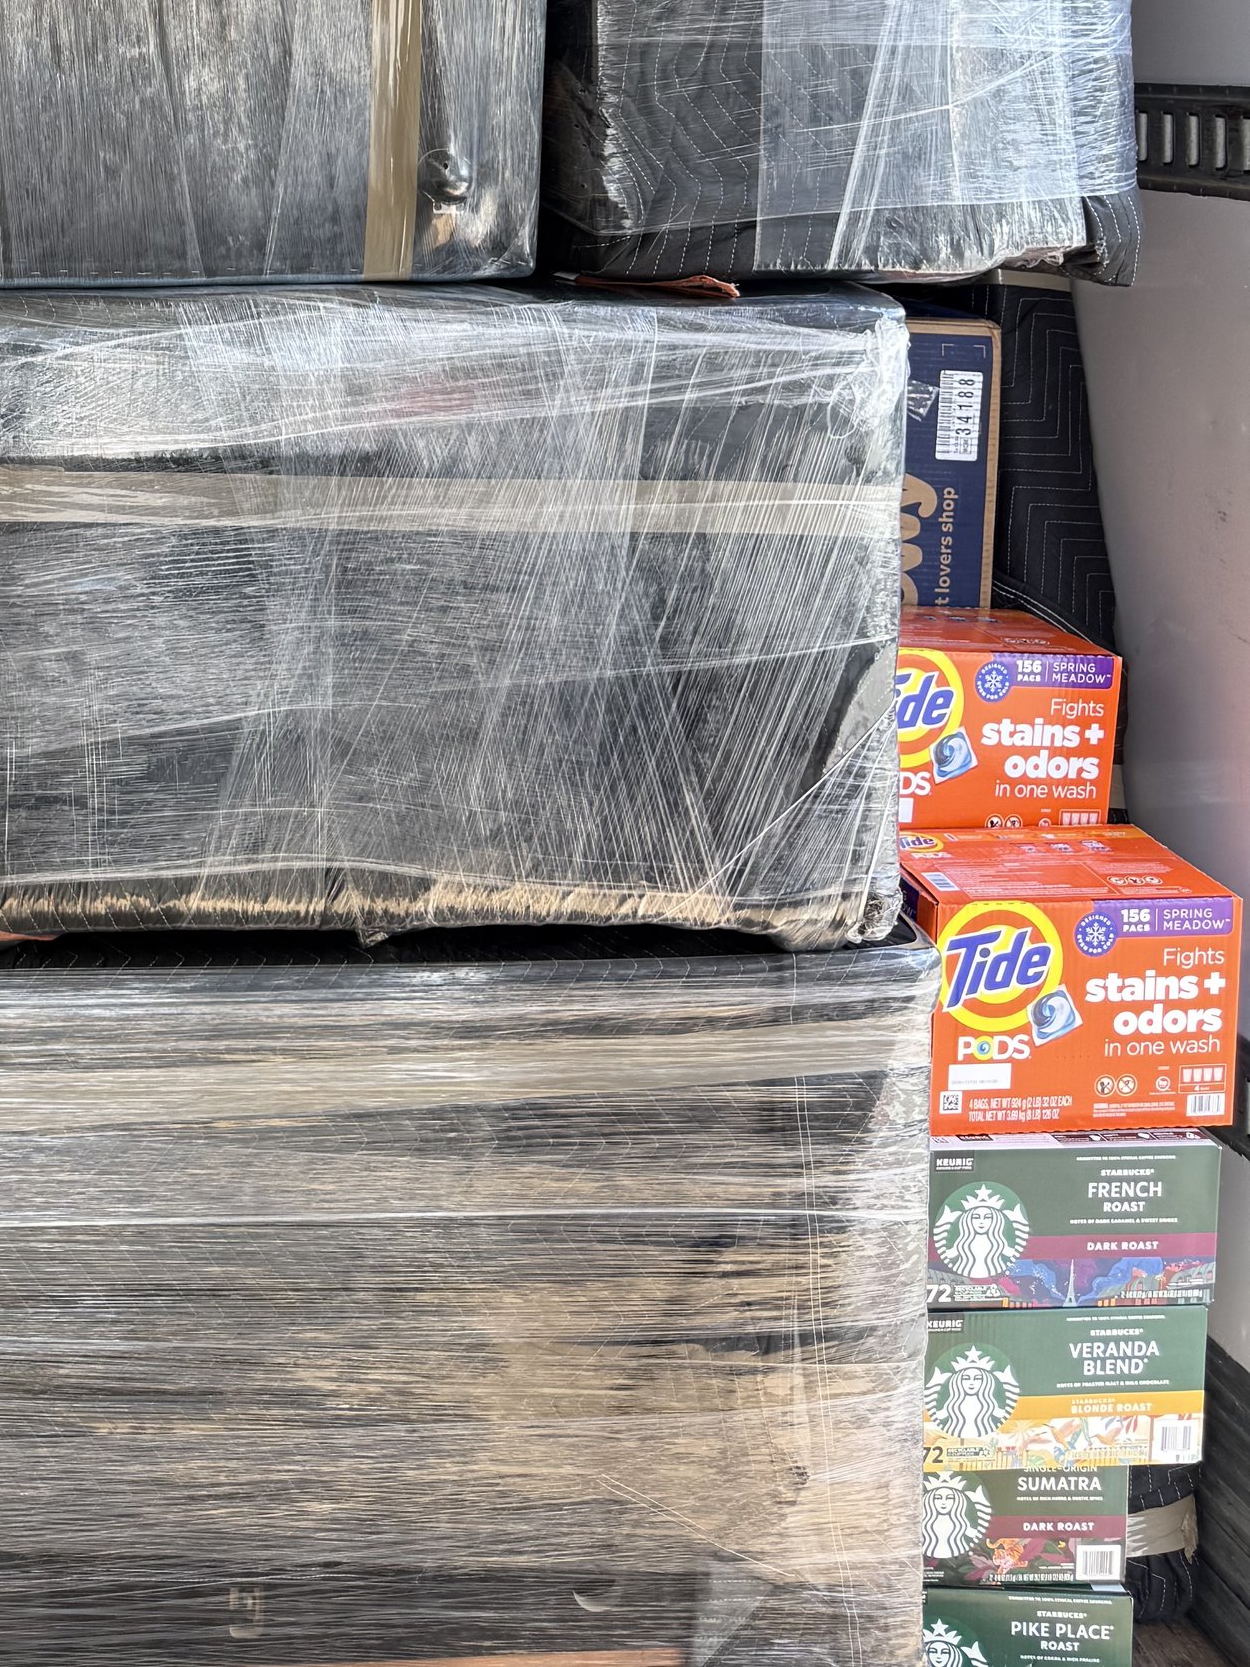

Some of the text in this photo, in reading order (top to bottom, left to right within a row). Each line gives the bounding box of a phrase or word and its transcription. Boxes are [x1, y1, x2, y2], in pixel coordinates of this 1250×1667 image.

[956, 377, 975, 436] 34188
[939, 487, 959, 532] shop
[935, 536, 952, 593] lovers
[1016, 660, 1042, 673] 156
[1053, 662, 1096, 673] SPRING
[1050, 698, 1104, 719] Fights
[981, 718, 1080, 748] stains
[1004, 749, 1099, 779] odors
[900, 771, 931, 796] DS
[995, 780, 1097, 799] in one wash
[1121, 908, 1150, 923] 156
[1163, 908, 1213, 920] SPRING
[1163, 947, 1225, 969] Fights
[944, 928, 1052, 1011] Tide
[1085, 969, 1199, 1003] stains
[1113, 1003, 1223, 1036] odors
[957, 1034, 1031, 1062] PODS
[1104, 1035, 1220, 1057] in one wash
[990, 1098, 1001, 1109] NET
[1001, 1097, 1011, 1109] WT
[1058, 1095, 1073, 1107] EACH
[969, 1111, 985, 1122] TOTAL
[985, 1111, 997, 1122] NET
[997, 1110, 1006, 1121] WT
[936, 1158, 973, 1166] KEURIG
[1088, 1181, 1162, 1198] FRENCH
[1103, 1201, 1146, 1212] ROAST
[1087, 1241, 1159, 1251] DARK ROAST
[927, 1284, 952, 1303] 72
[1069, 1340, 1160, 1359] VERANDA
[1071, 1403, 1152, 1414] BLONDE ROAST
[923, 1446, 943, 1463] 72
[1017, 1476, 1102, 1491] SUMATRA
[1023, 1522, 1094, 1531] DARK ROAST
[1011, 1621, 1050, 1637] PIKE
[1040, 1641, 1080, 1652] ROAST
